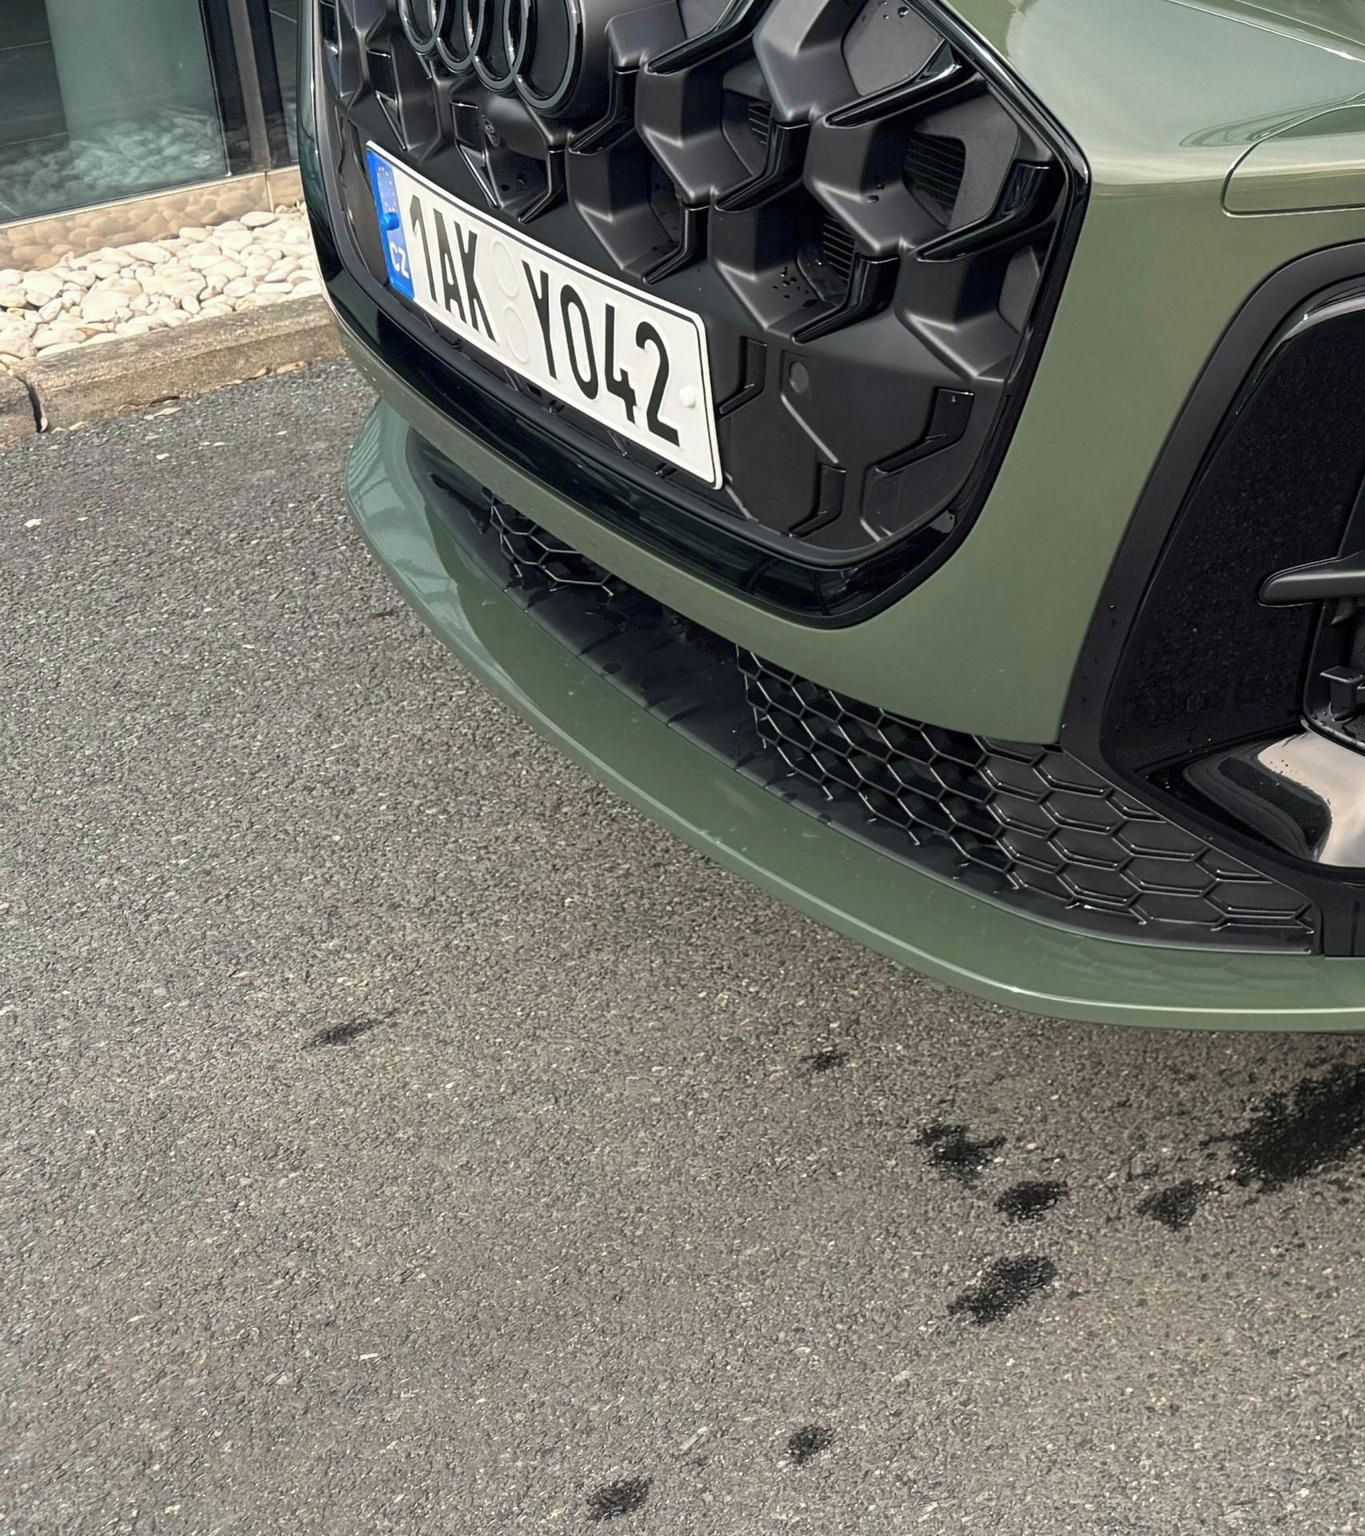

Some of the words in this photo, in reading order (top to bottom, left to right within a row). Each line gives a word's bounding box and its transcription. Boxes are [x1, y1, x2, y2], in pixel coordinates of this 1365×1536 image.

[388, 240, 410, 279] CZ
[409, 194, 498, 344] 1AK
[521, 259, 681, 448] Y042
